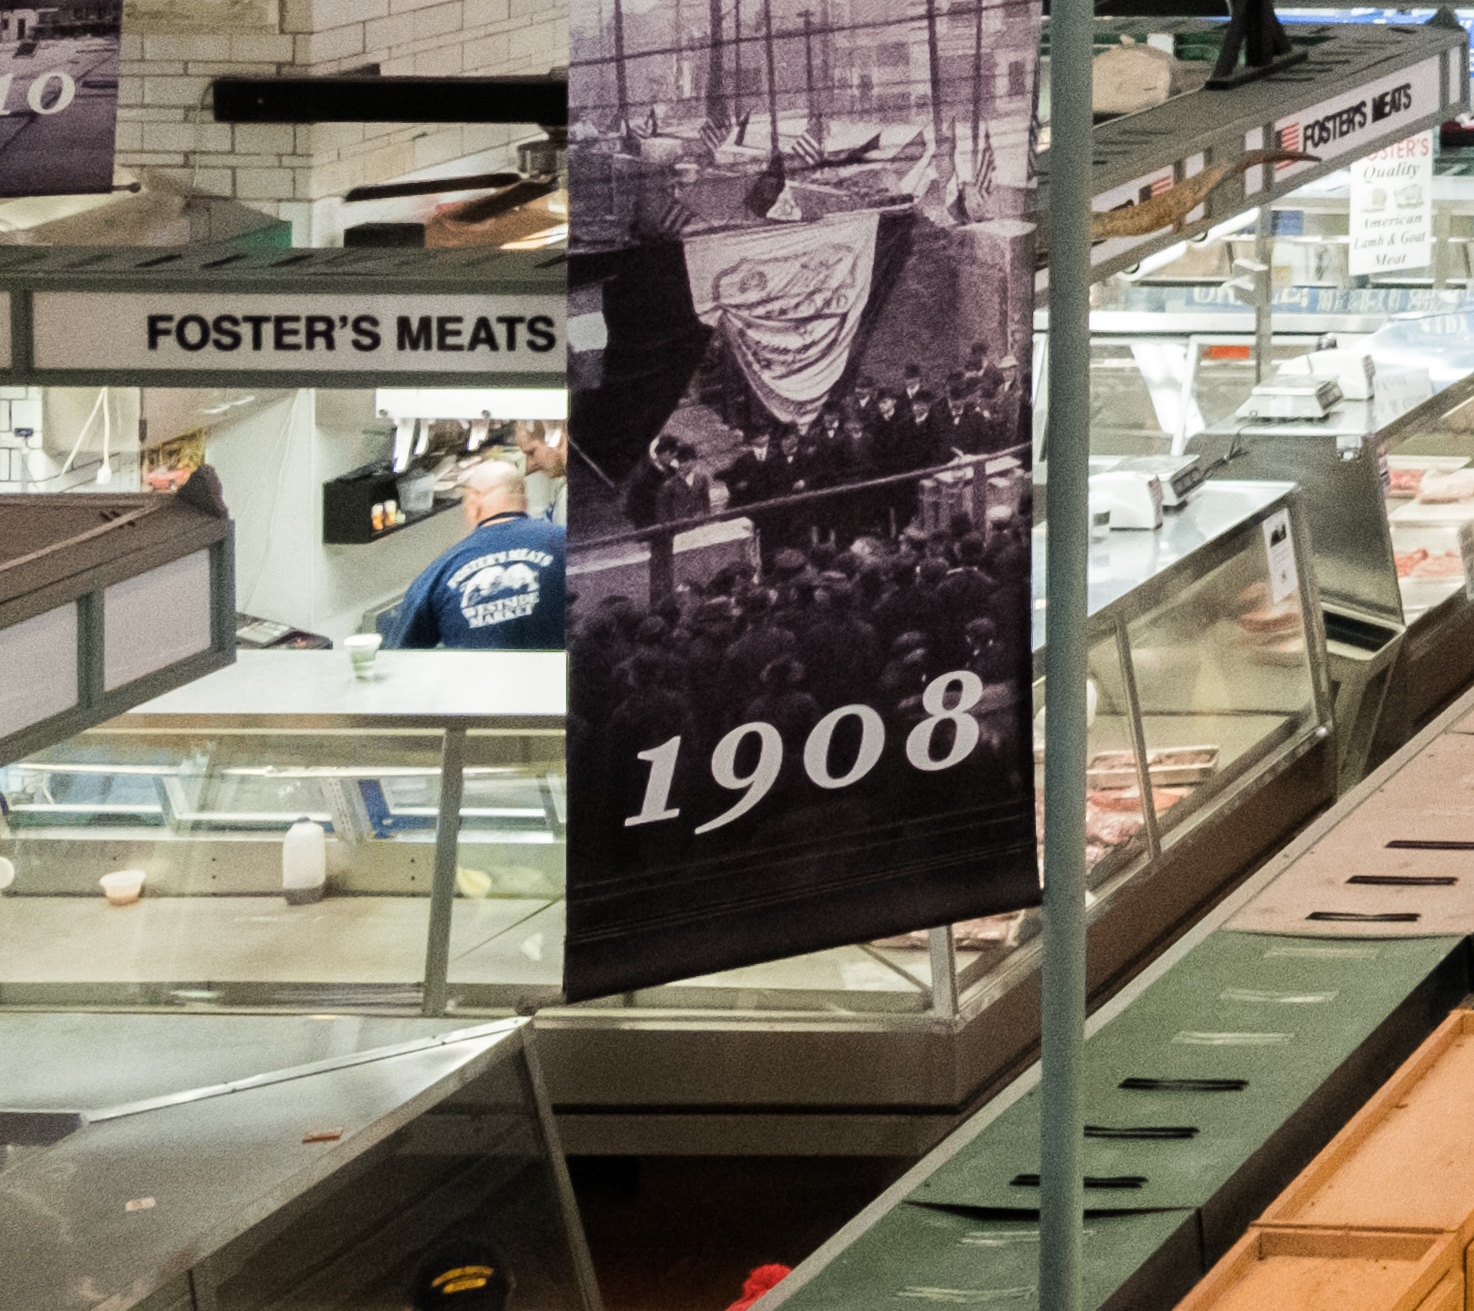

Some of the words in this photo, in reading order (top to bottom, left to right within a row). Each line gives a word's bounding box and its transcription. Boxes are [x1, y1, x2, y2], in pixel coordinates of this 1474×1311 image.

[1302, 100, 1368, 154] FOSTER'S
[1372, 82, 1413, 124] MEATS
[1363, 161, 1421, 184] Quality
[1353, 236, 1384, 251] Lamb
[1400, 230, 1427, 245] Goat
[1374, 252, 1408, 266] Meat
[147, 313, 381, 352] FOSTER'S
[397, 314, 557, 353] MEATS
[446, 551, 508, 589] FOSTER'S
[508, 547, 554, 568] MEATS
[469, 604, 534, 629] MARKET
[624, 670, 985, 835] 1908
